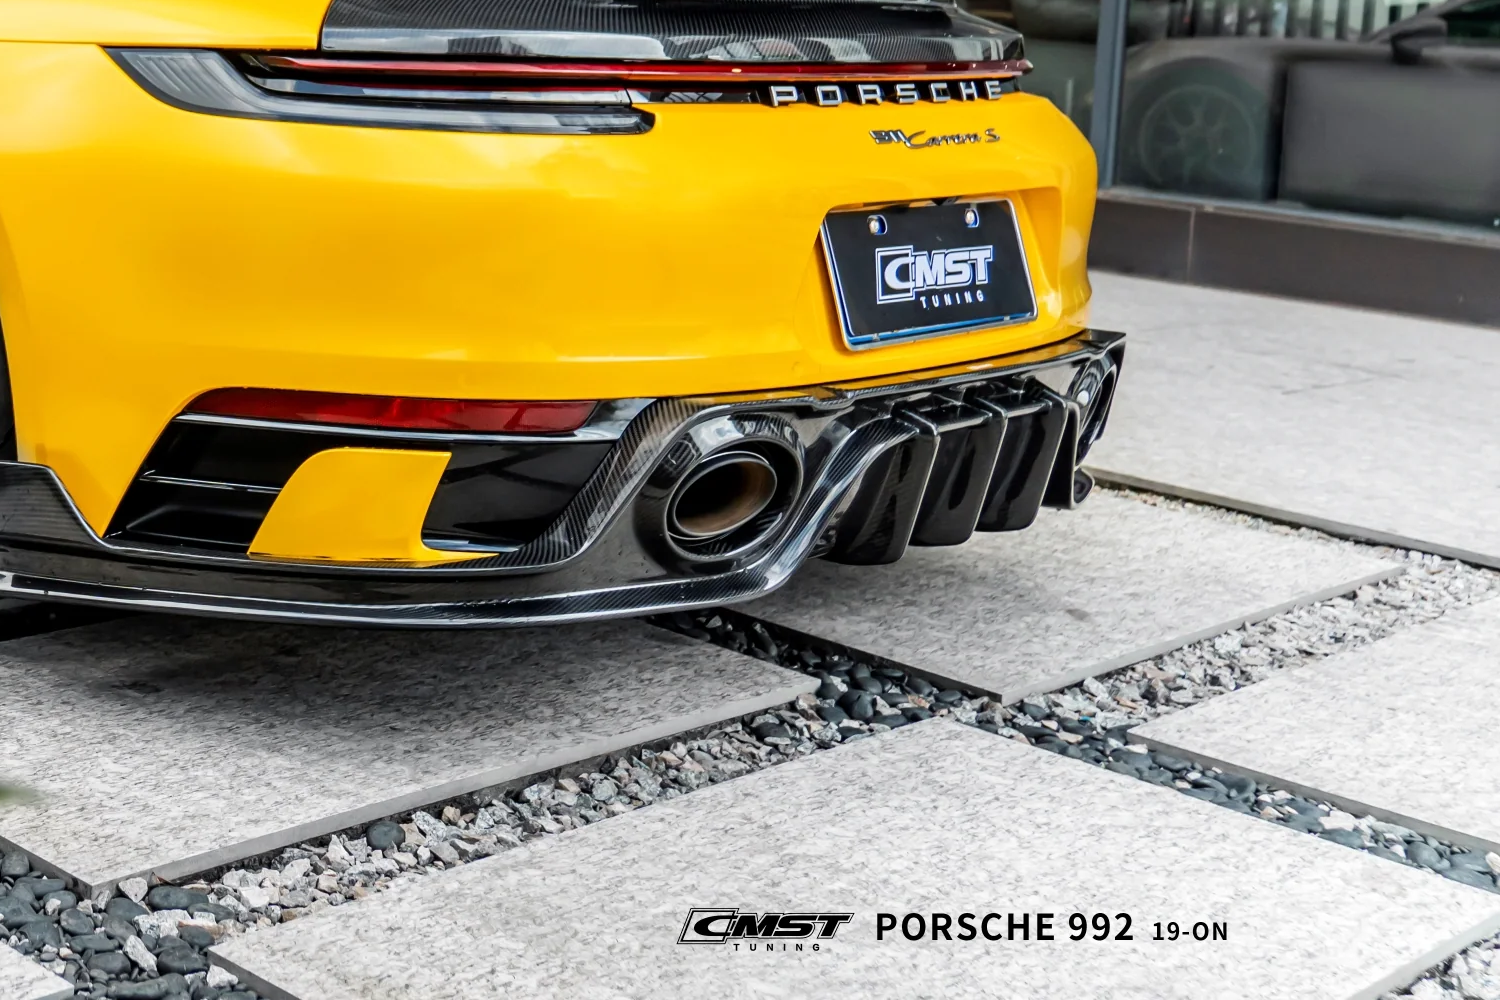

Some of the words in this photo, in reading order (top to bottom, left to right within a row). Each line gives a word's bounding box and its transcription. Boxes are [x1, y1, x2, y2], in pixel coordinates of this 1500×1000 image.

[768, 79, 1002, 107] PORSCHE
[868, 129, 907, 145] 911
[902, 130, 982, 149] Carrera
[983, 127, 1001, 143] S
[875, 245, 994, 305] CMST
[919, 291, 986, 310] TUNING
